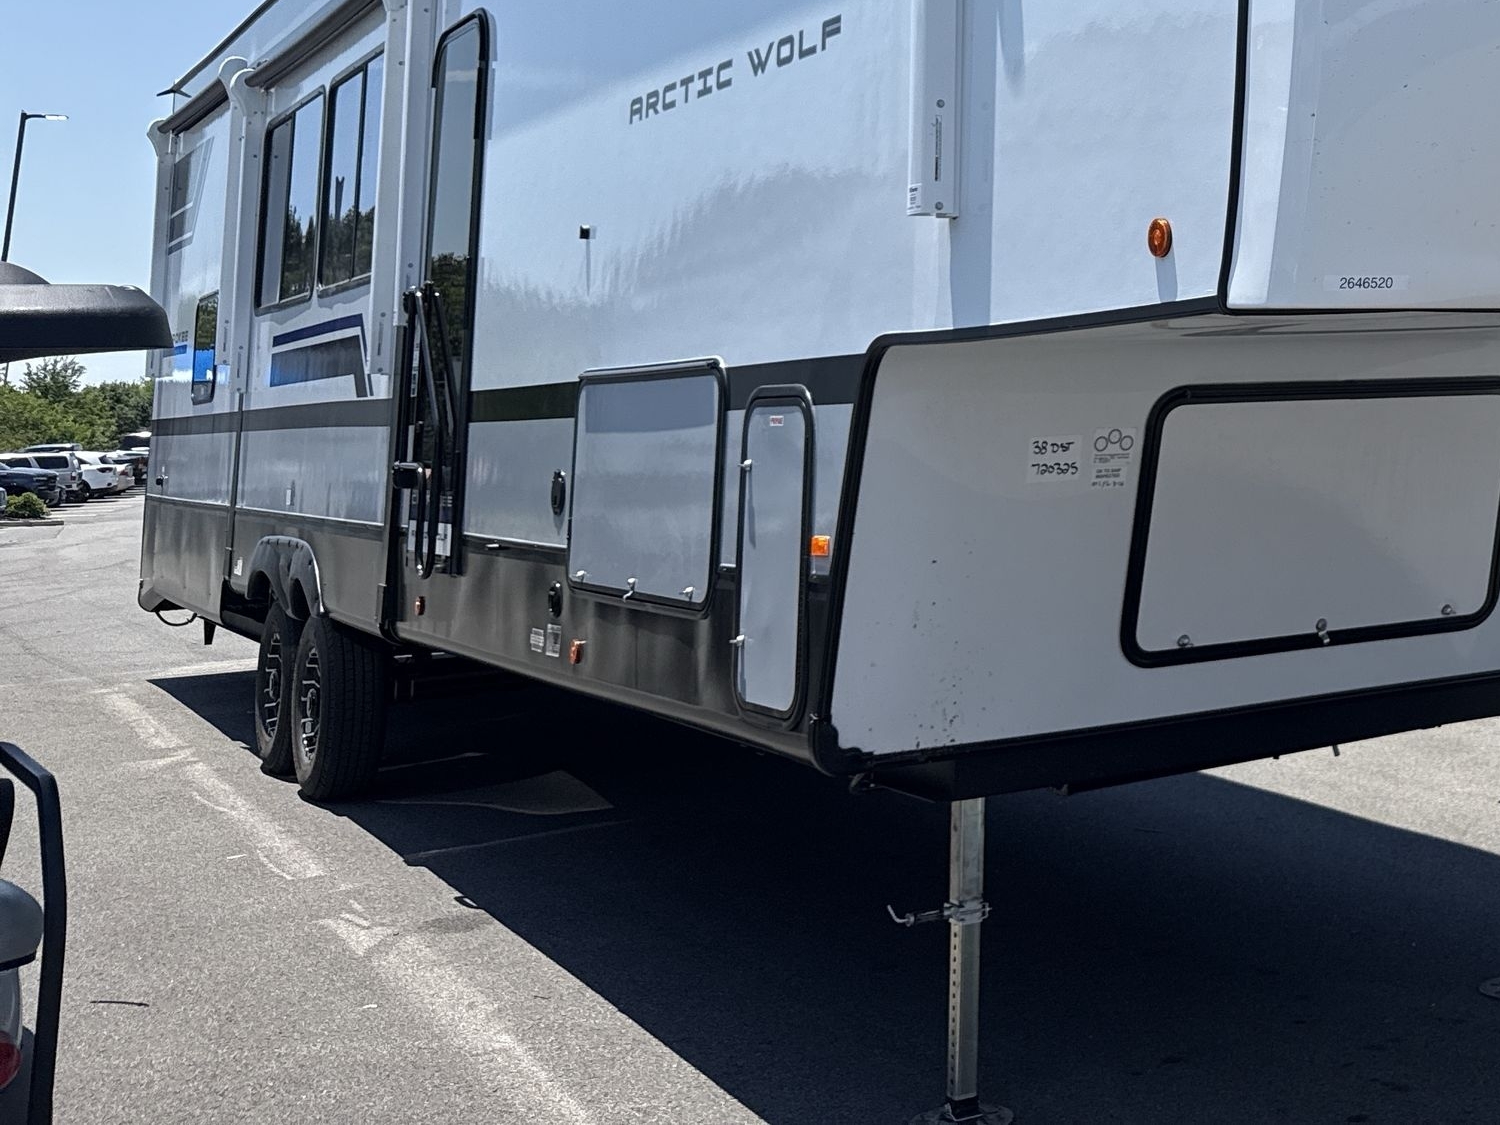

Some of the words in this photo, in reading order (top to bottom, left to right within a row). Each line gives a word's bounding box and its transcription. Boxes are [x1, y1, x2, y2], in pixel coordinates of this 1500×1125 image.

[629, 58, 734, 126] ARCTIC
[747, 13, 842, 78] WOLF
[1339, 276, 1394, 290] 2646520
[1032, 440, 1049, 455] 38
[1031, 461, 1079, 476] 720325
